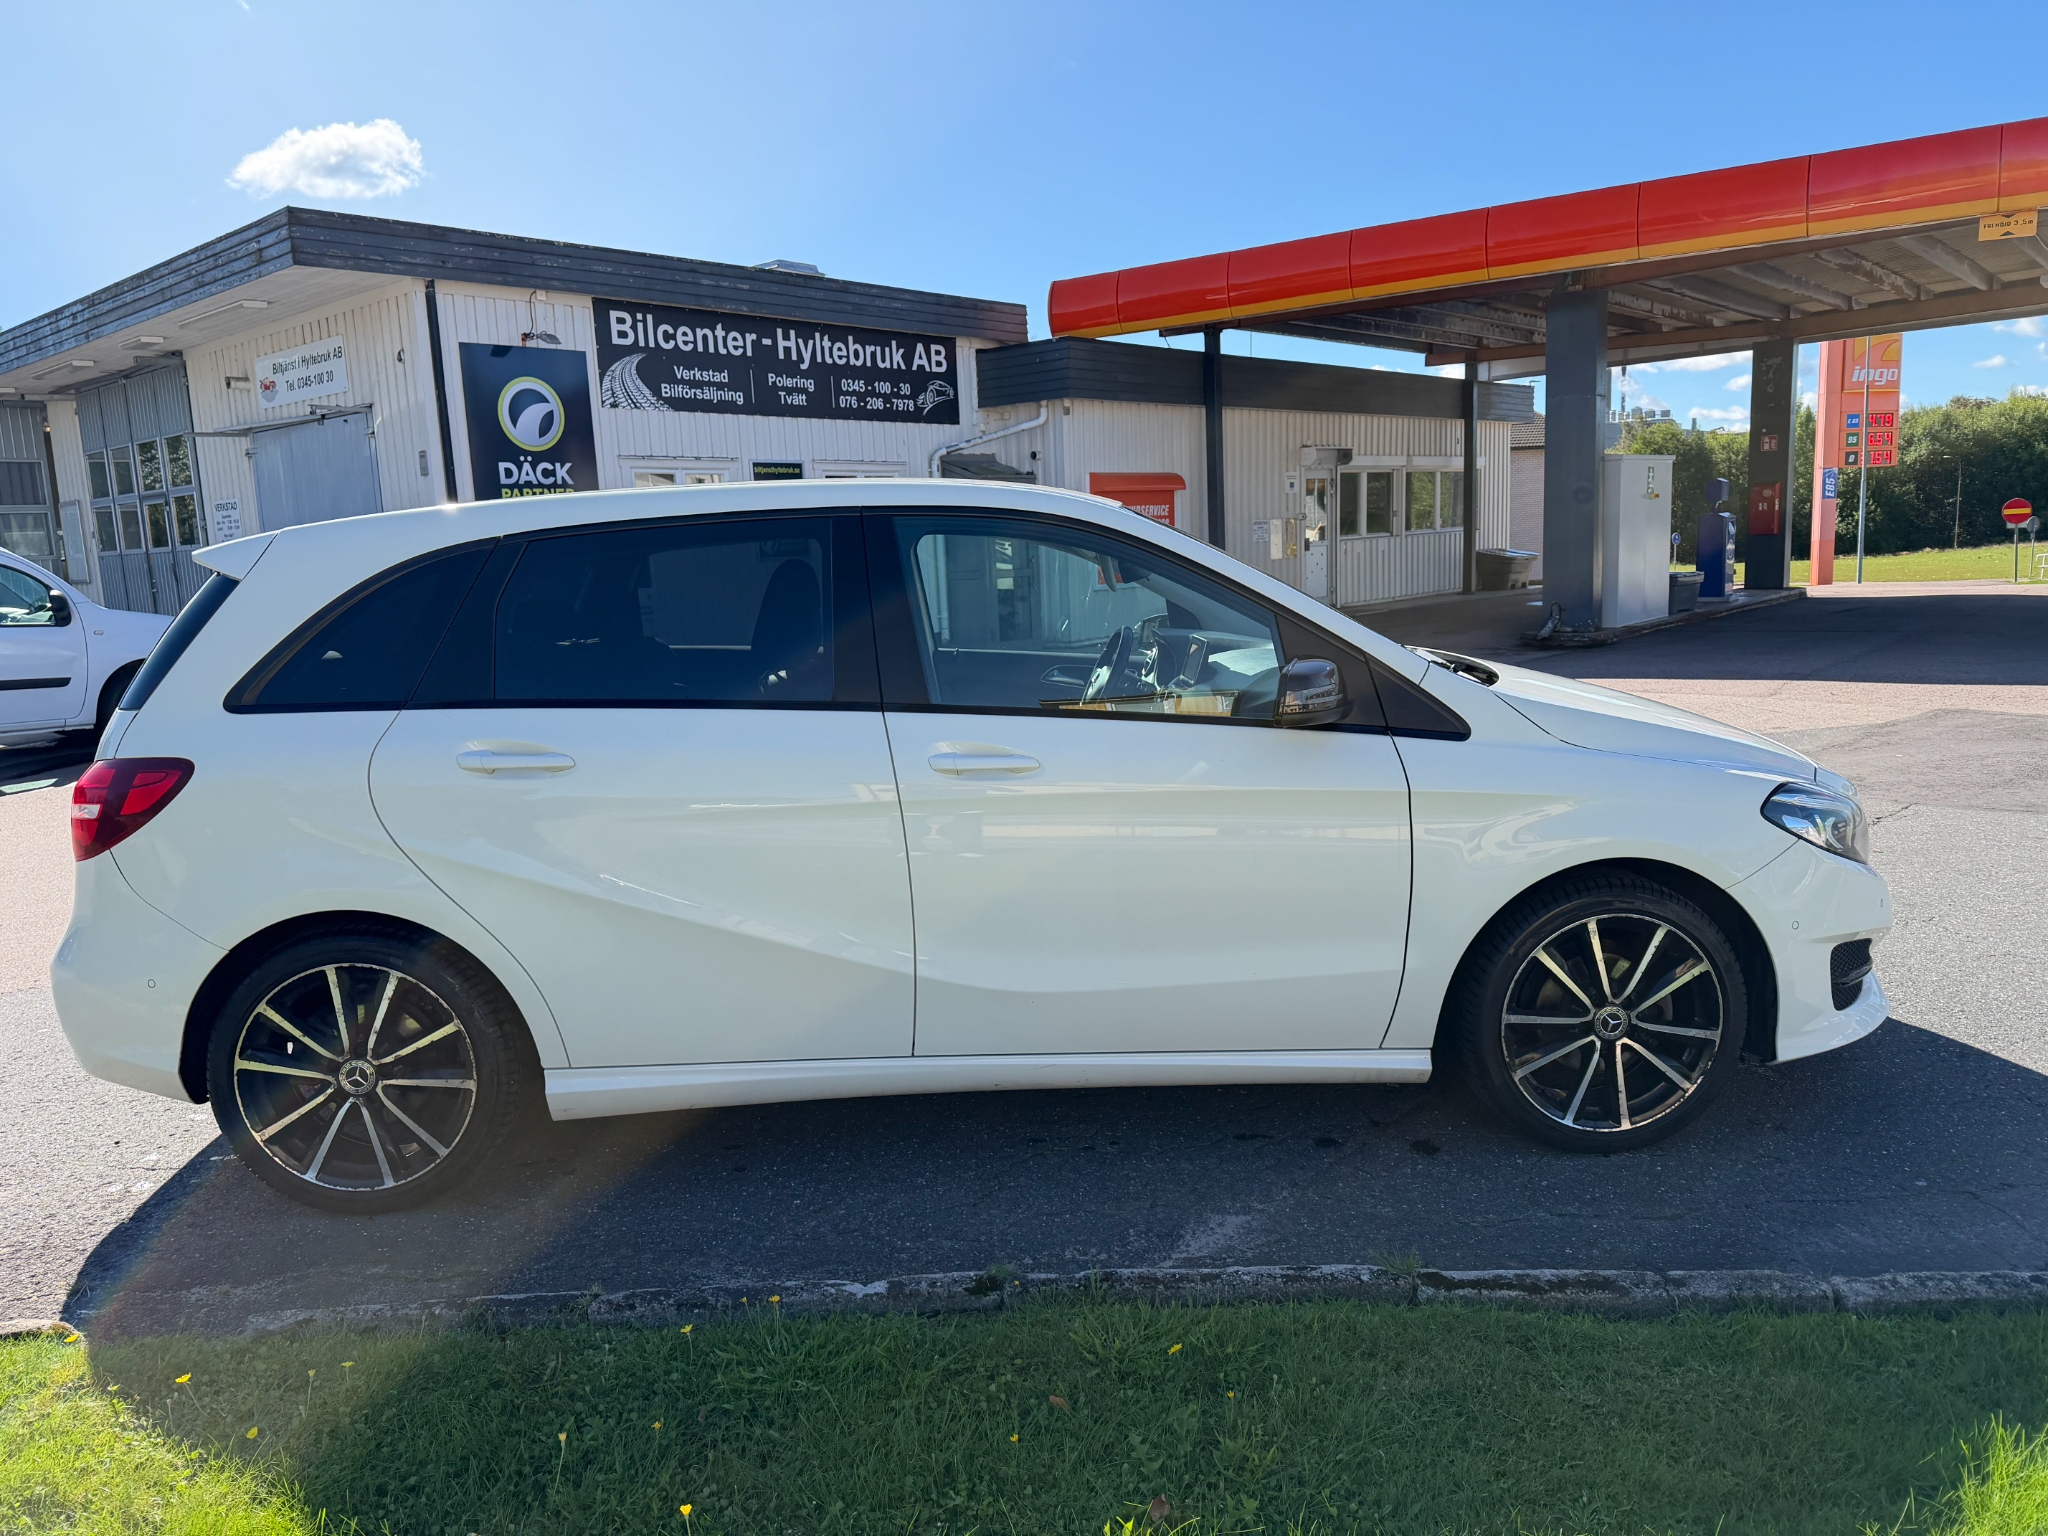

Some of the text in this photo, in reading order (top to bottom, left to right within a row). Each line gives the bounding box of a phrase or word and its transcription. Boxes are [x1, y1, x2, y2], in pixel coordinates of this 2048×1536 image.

[609, 310, 757, 356] Bilcenter
[776, 328, 906, 370] Hyltebruk
[912, 343, 947, 373] AB
[272, 359, 297, 376] Biltjänst
[301, 349, 332, 369] Hyltebruk
[333, 346, 343, 360] AB
[286, 370, 334, 392] Tel. 0345-100 30
[673, 365, 729, 382] Verkstad
[768, 373, 814, 392] Polering
[1852, 365, 1899, 386] ingo
[661, 383, 744, 405] Bilförsäljning
[779, 392, 807, 405] Tvätt
[892, 399, 914, 411] 7978
[1847, 435, 1858, 444] 95
[1848, 454, 1856, 463] D
[498, 455, 574, 485] DÄCK
[1825, 477, 1836, 497] E85
[214, 501, 238, 512] VERKSTAD
